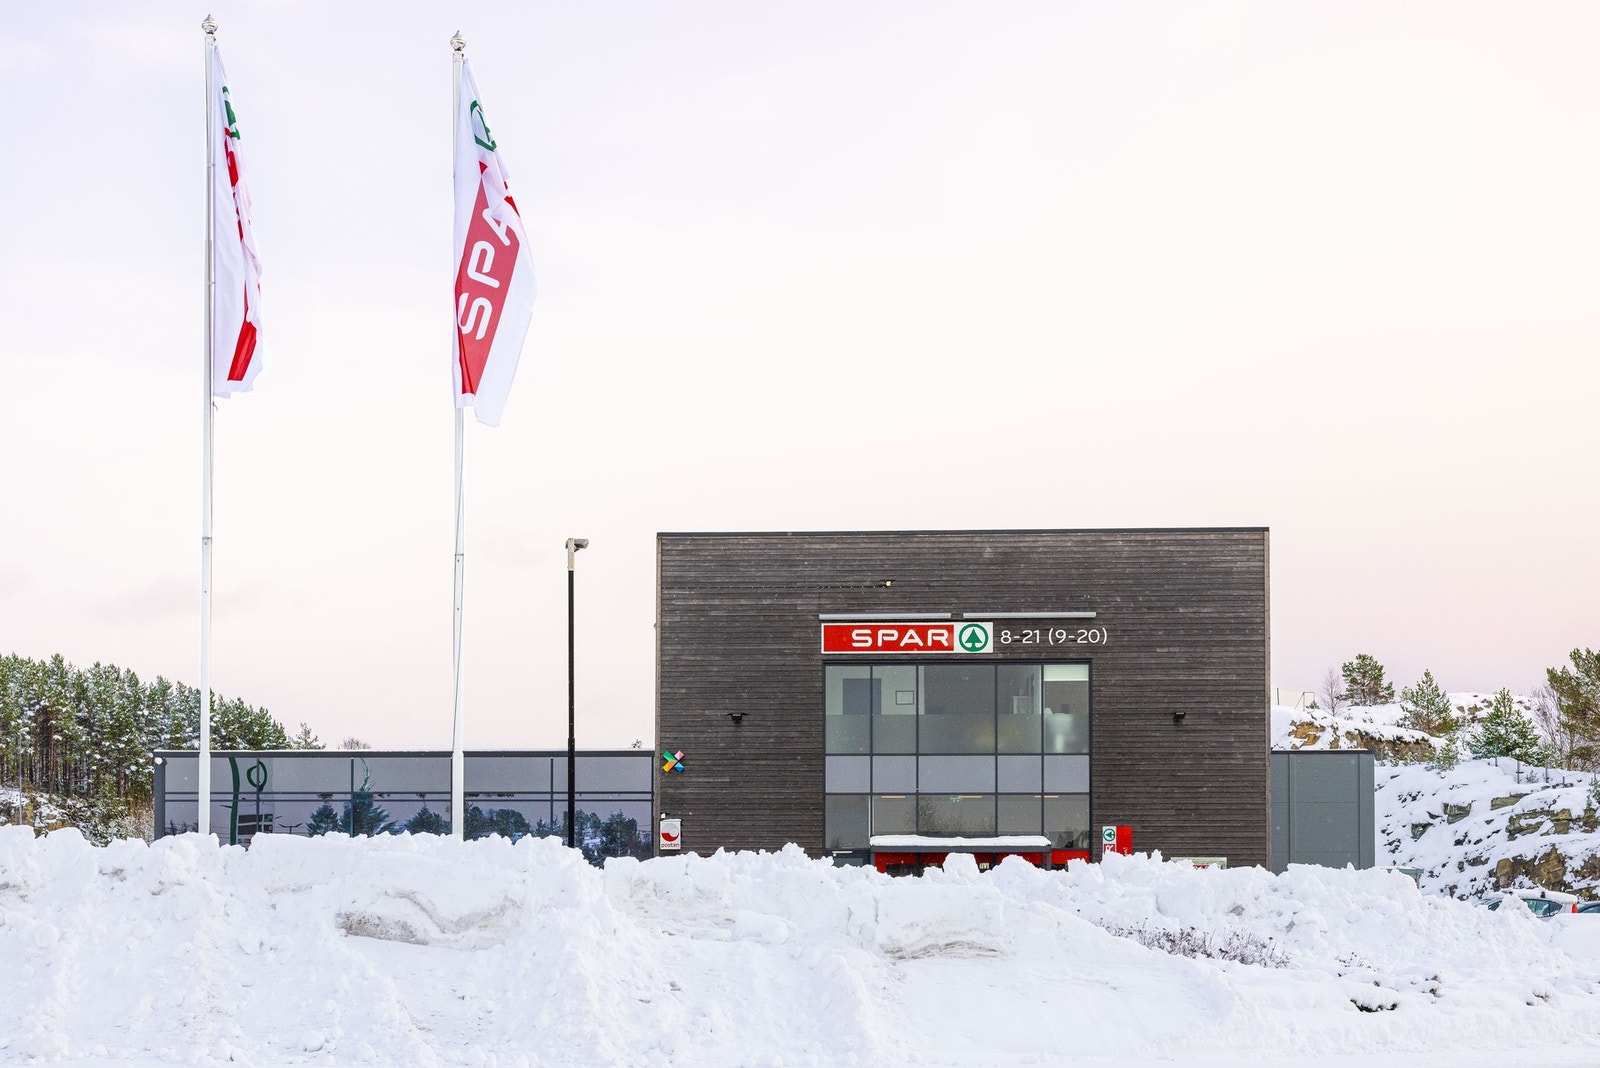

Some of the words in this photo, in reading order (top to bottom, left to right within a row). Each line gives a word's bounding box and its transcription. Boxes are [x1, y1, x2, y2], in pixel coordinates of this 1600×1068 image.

[458, 207, 512, 341] SPA
[851, 629, 949, 647] SPAR
[1000, 629, 1041, 645] 8-21
[1047, 627, 1108, 646] (9-20)
